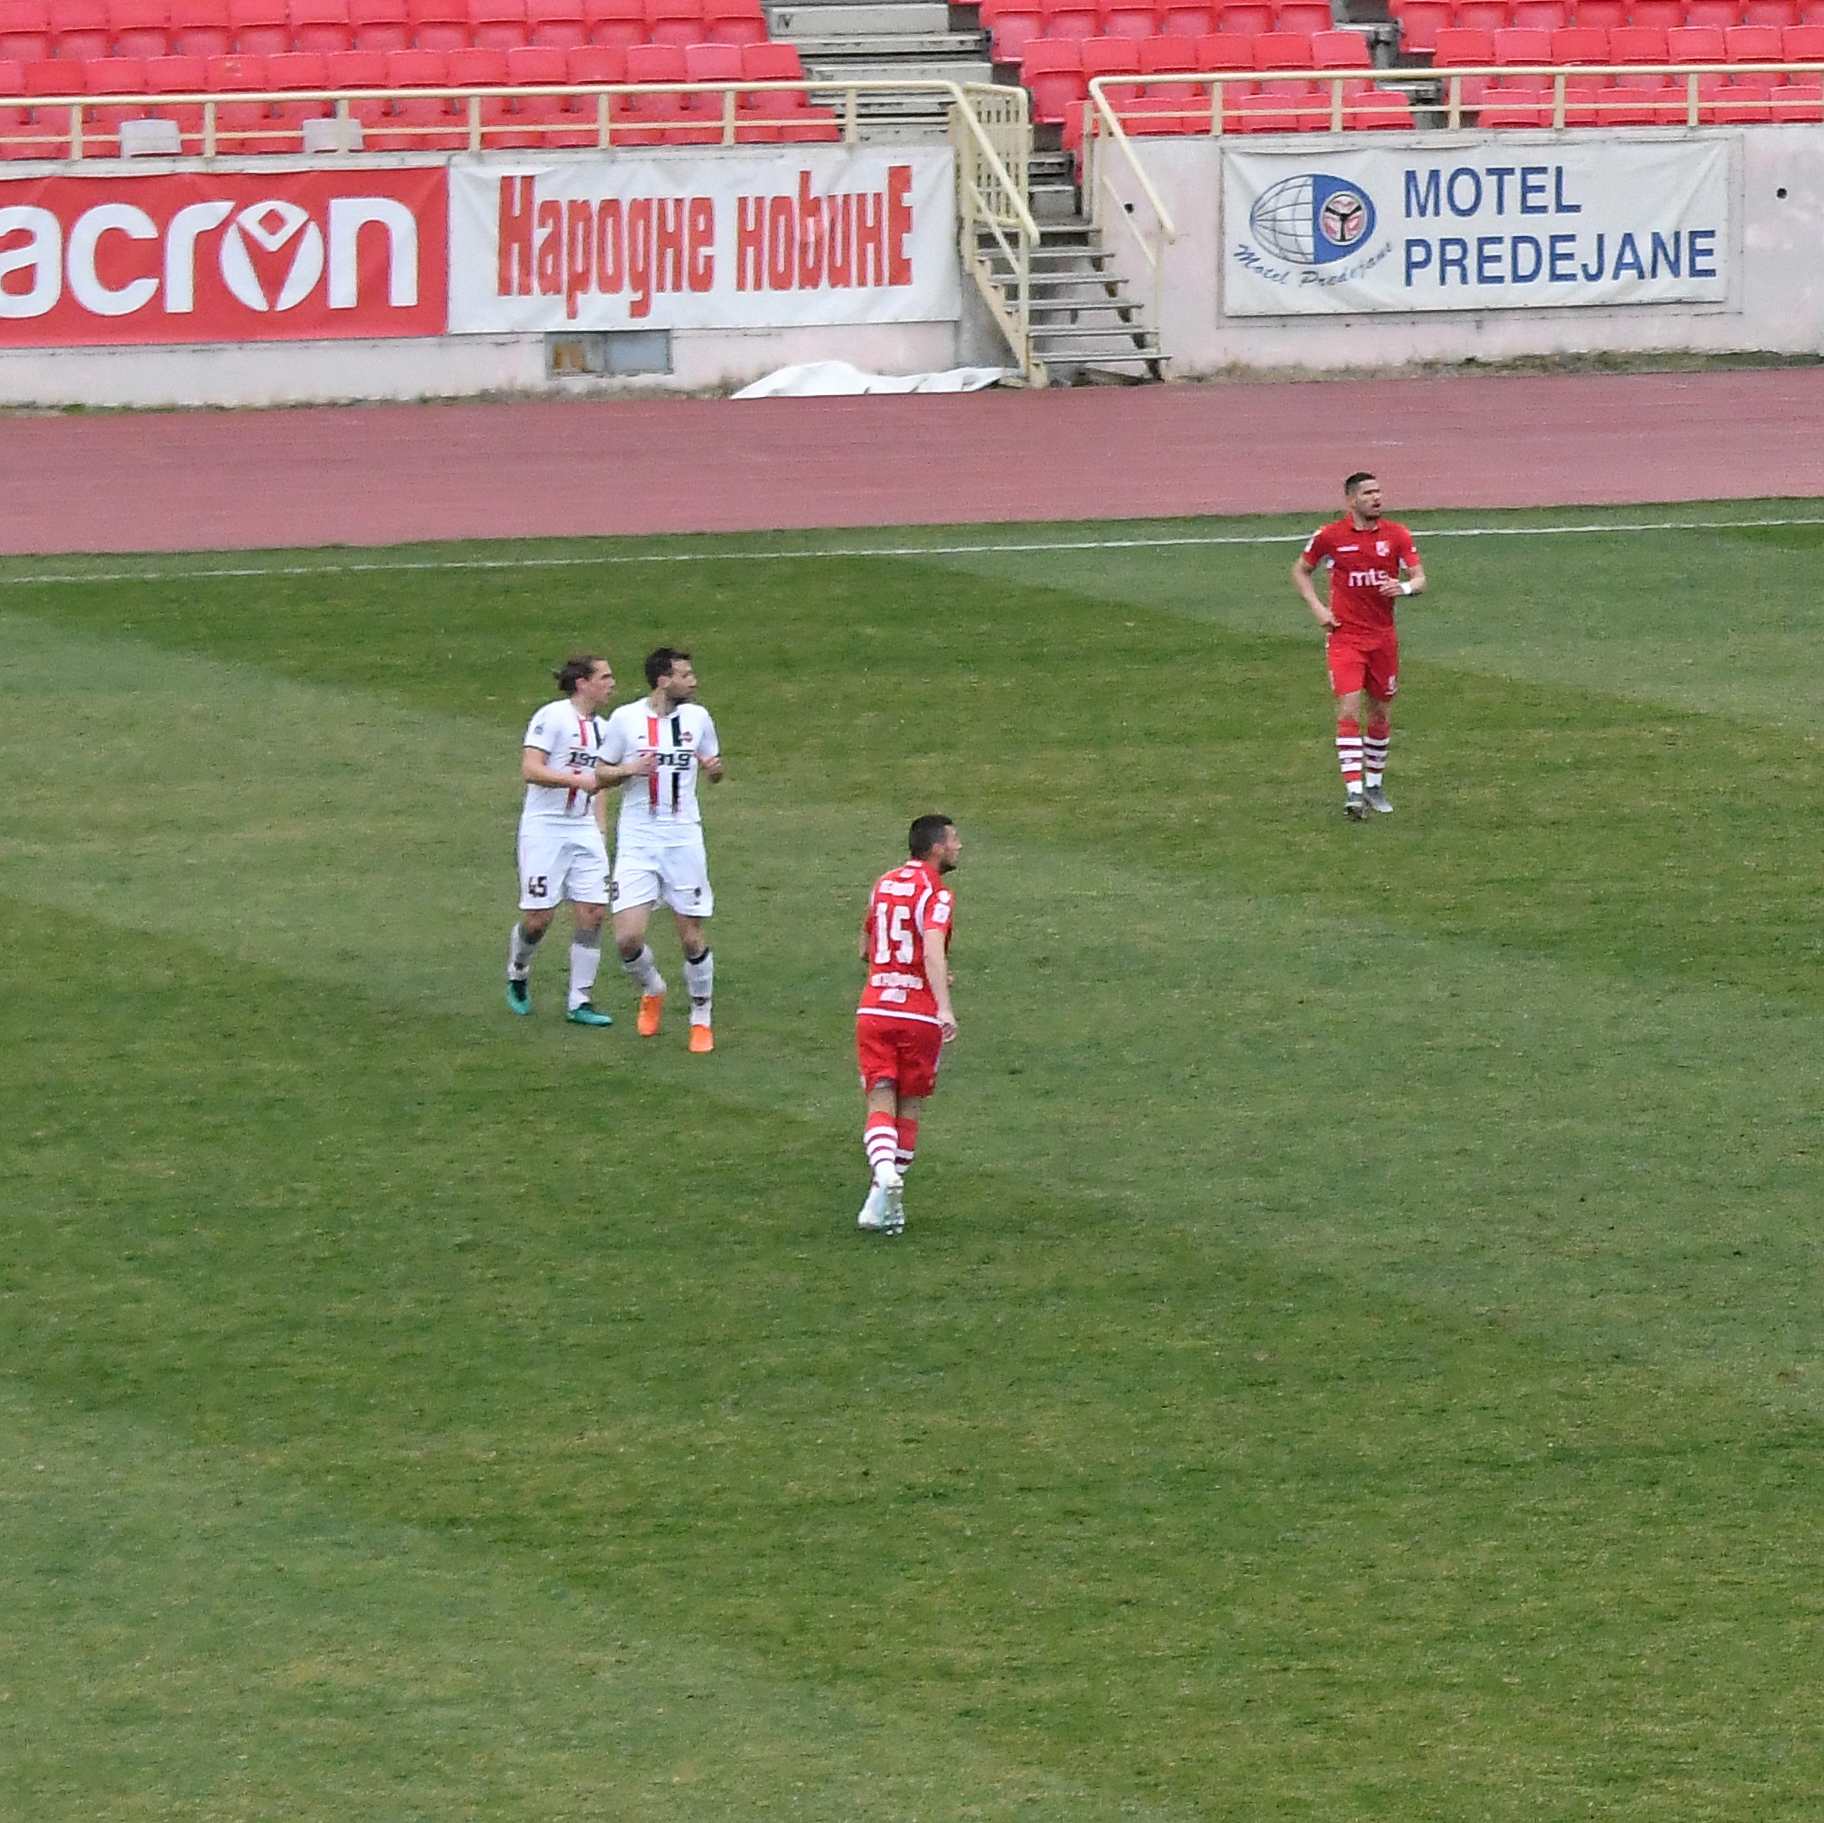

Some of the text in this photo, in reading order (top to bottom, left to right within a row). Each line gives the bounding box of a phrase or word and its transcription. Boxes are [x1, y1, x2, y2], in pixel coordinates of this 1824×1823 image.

[1404, 166, 1582, 218] MOTEL
[497, 175, 716, 319] Народне
[1404, 229, 1717, 287] PREDEJANE
[529, 875, 548, 898] 45
[874, 901, 914, 965] 15
